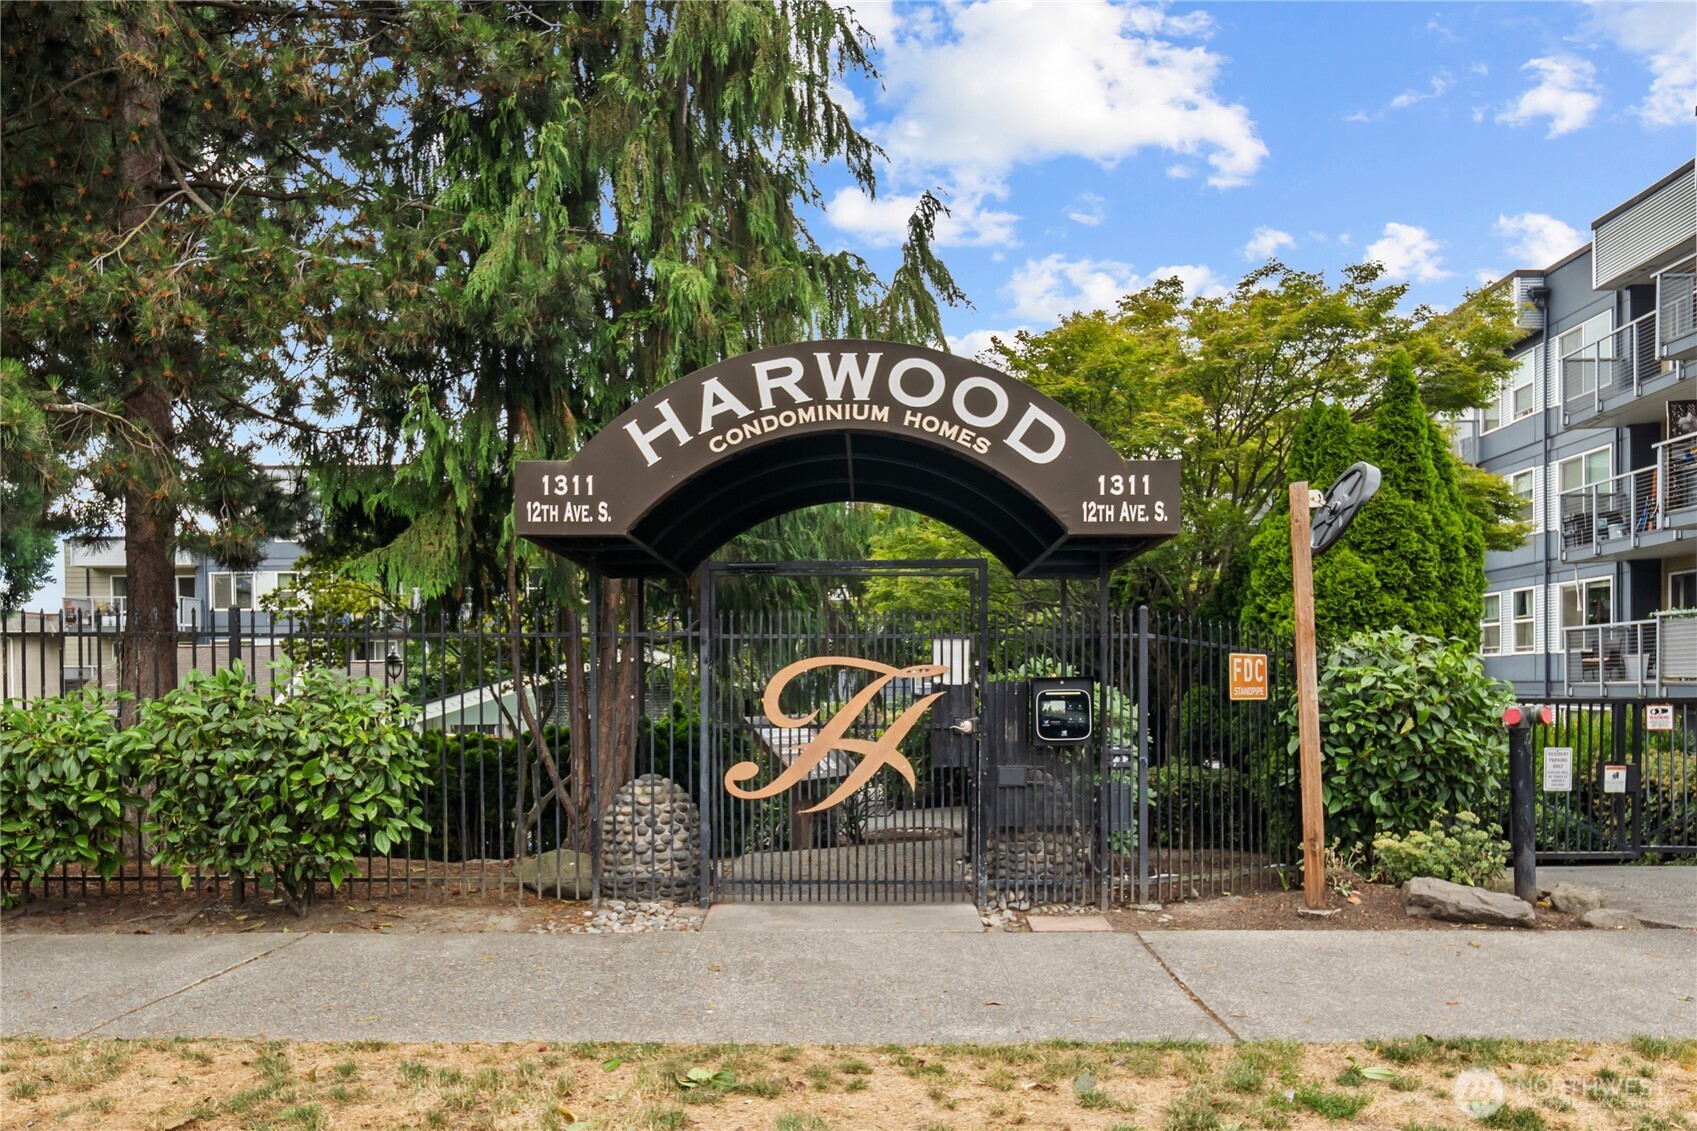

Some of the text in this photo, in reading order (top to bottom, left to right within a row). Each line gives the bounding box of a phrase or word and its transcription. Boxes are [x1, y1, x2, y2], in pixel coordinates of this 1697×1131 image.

[623, 352, 1066, 467] HARWOOD
[709, 404, 992, 455] CONDOMINIUM HOMES
[541, 474, 594, 496] 1311
[1097, 474, 1150, 496] 1311
[526, 501, 612, 523] 12TH AVE. S.
[1082, 501, 1168, 523] 12TH AVE. S.
[1233, 658, 1264, 683] FDC
[1234, 686, 1264, 696] STANDPIPE
